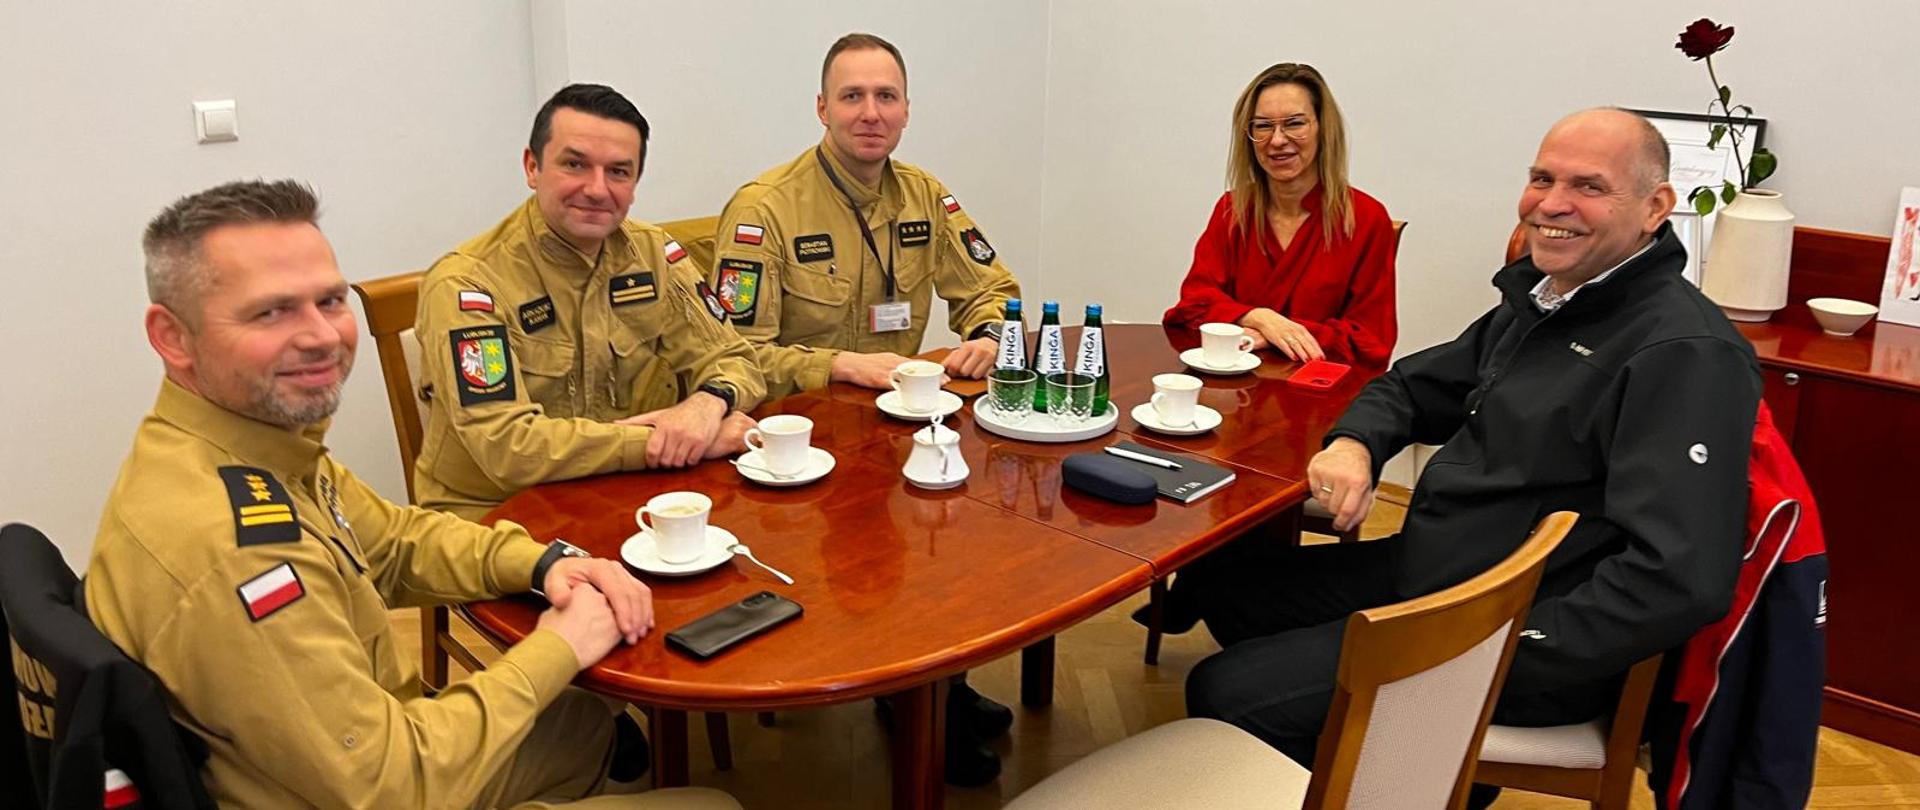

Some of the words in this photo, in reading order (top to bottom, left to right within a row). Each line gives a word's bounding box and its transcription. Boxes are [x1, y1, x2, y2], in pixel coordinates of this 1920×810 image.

[1006, 327, 1016, 365] KINGA
[1050, 331, 1059, 369] KINGA
[1083, 333, 1095, 371] KINGA
